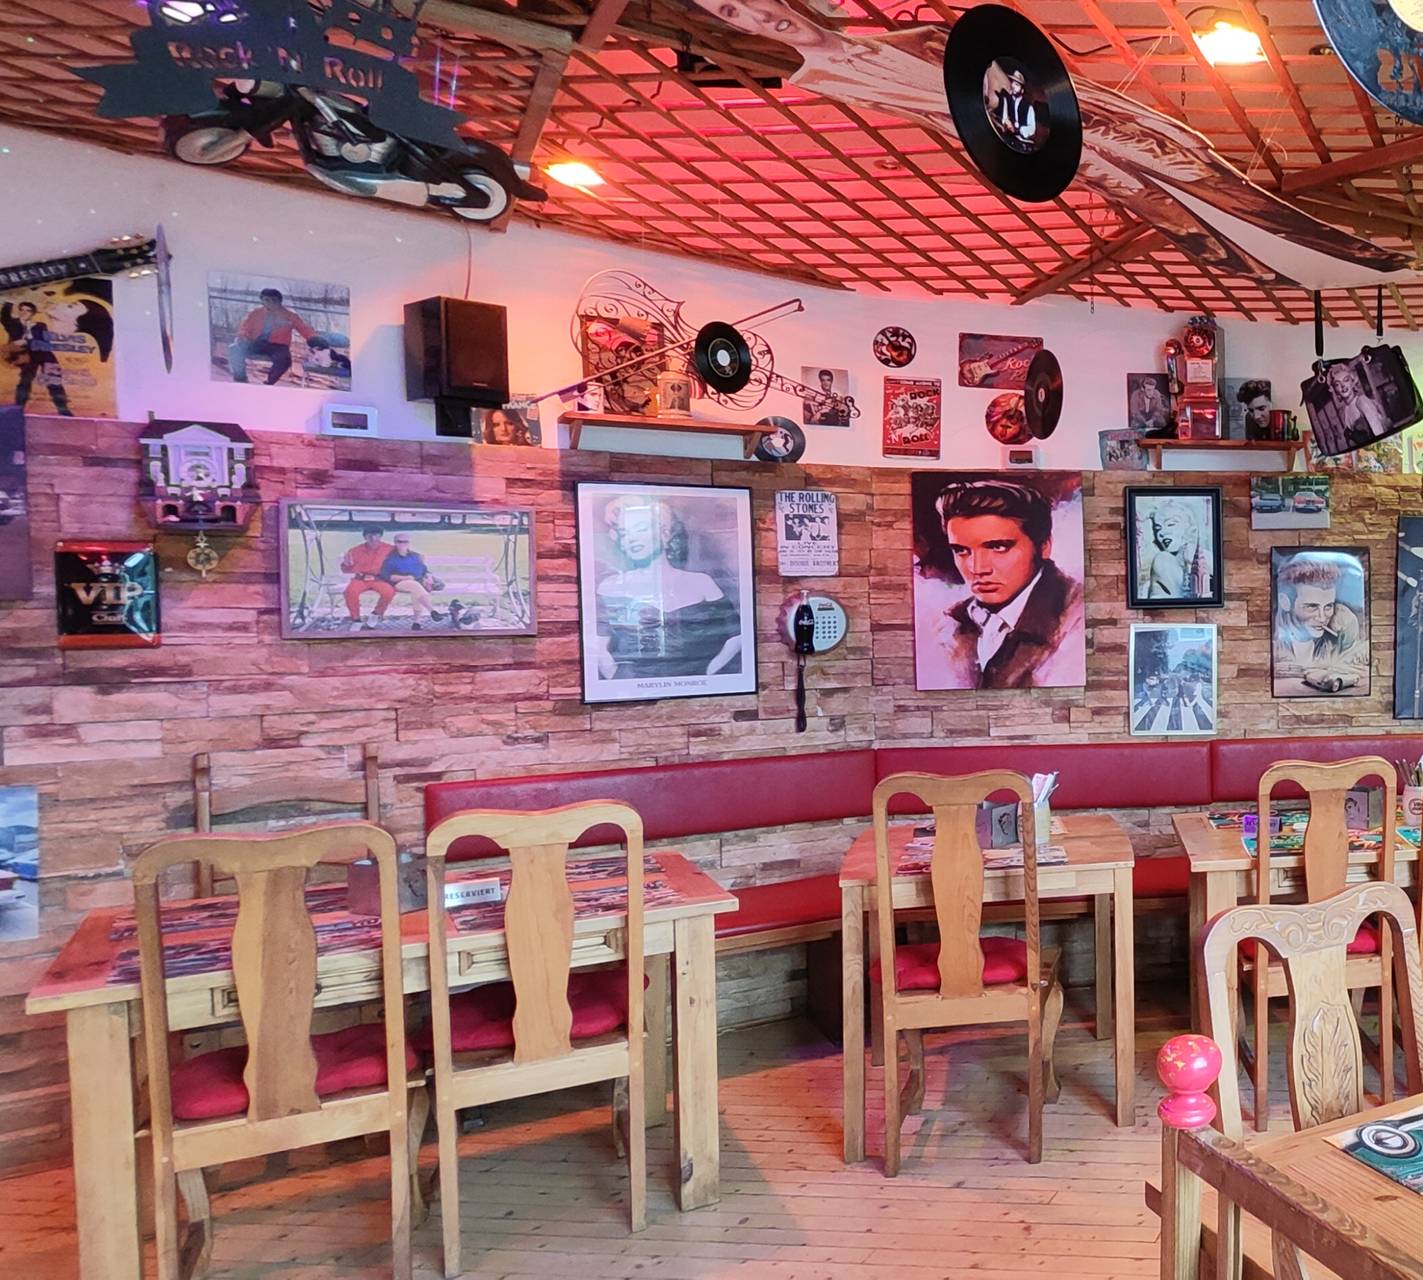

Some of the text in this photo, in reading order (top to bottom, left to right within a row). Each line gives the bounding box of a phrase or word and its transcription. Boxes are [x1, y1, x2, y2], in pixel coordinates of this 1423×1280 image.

[323, 56, 383, 89] Roll
[1000, 358, 1031, 372] Roc
[909, 388, 940, 400] ROCK
[902, 434, 934, 445] ROLL
[780, 492, 834, 504] THE ROLLING
[790, 503, 824, 514] STONES
[68, 582, 143, 606] VIP
